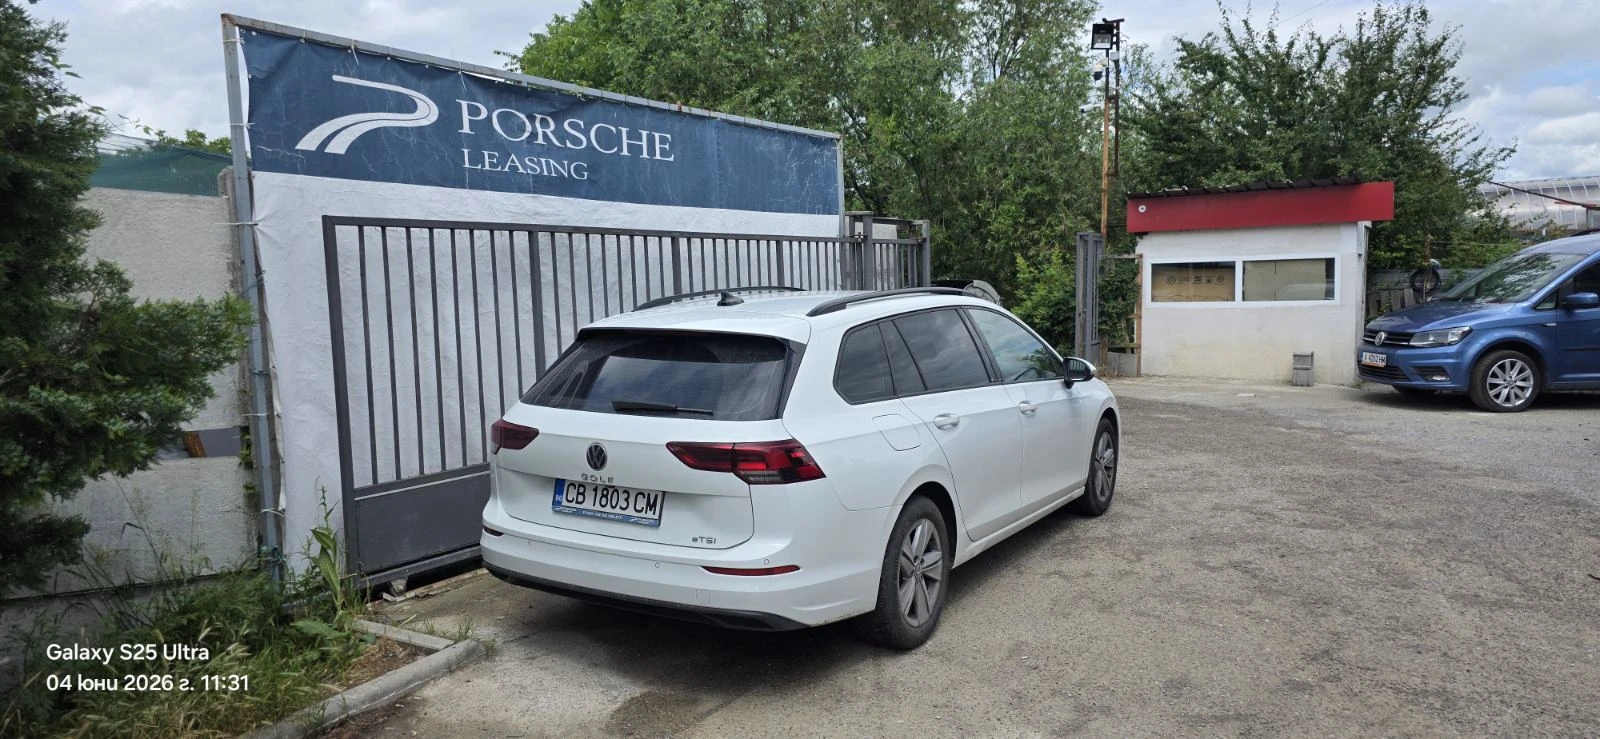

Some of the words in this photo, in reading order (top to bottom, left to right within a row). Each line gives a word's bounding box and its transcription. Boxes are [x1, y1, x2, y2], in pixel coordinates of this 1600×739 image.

[456, 99, 674, 162] PORSCHE
[461, 148, 588, 180] LEASING
[581, 473, 614, 483] GOLF
[565, 482, 587, 505] CB
[592, 485, 630, 512] 1803
[633, 491, 659, 515] CM
[691, 536, 717, 545] eTSI
